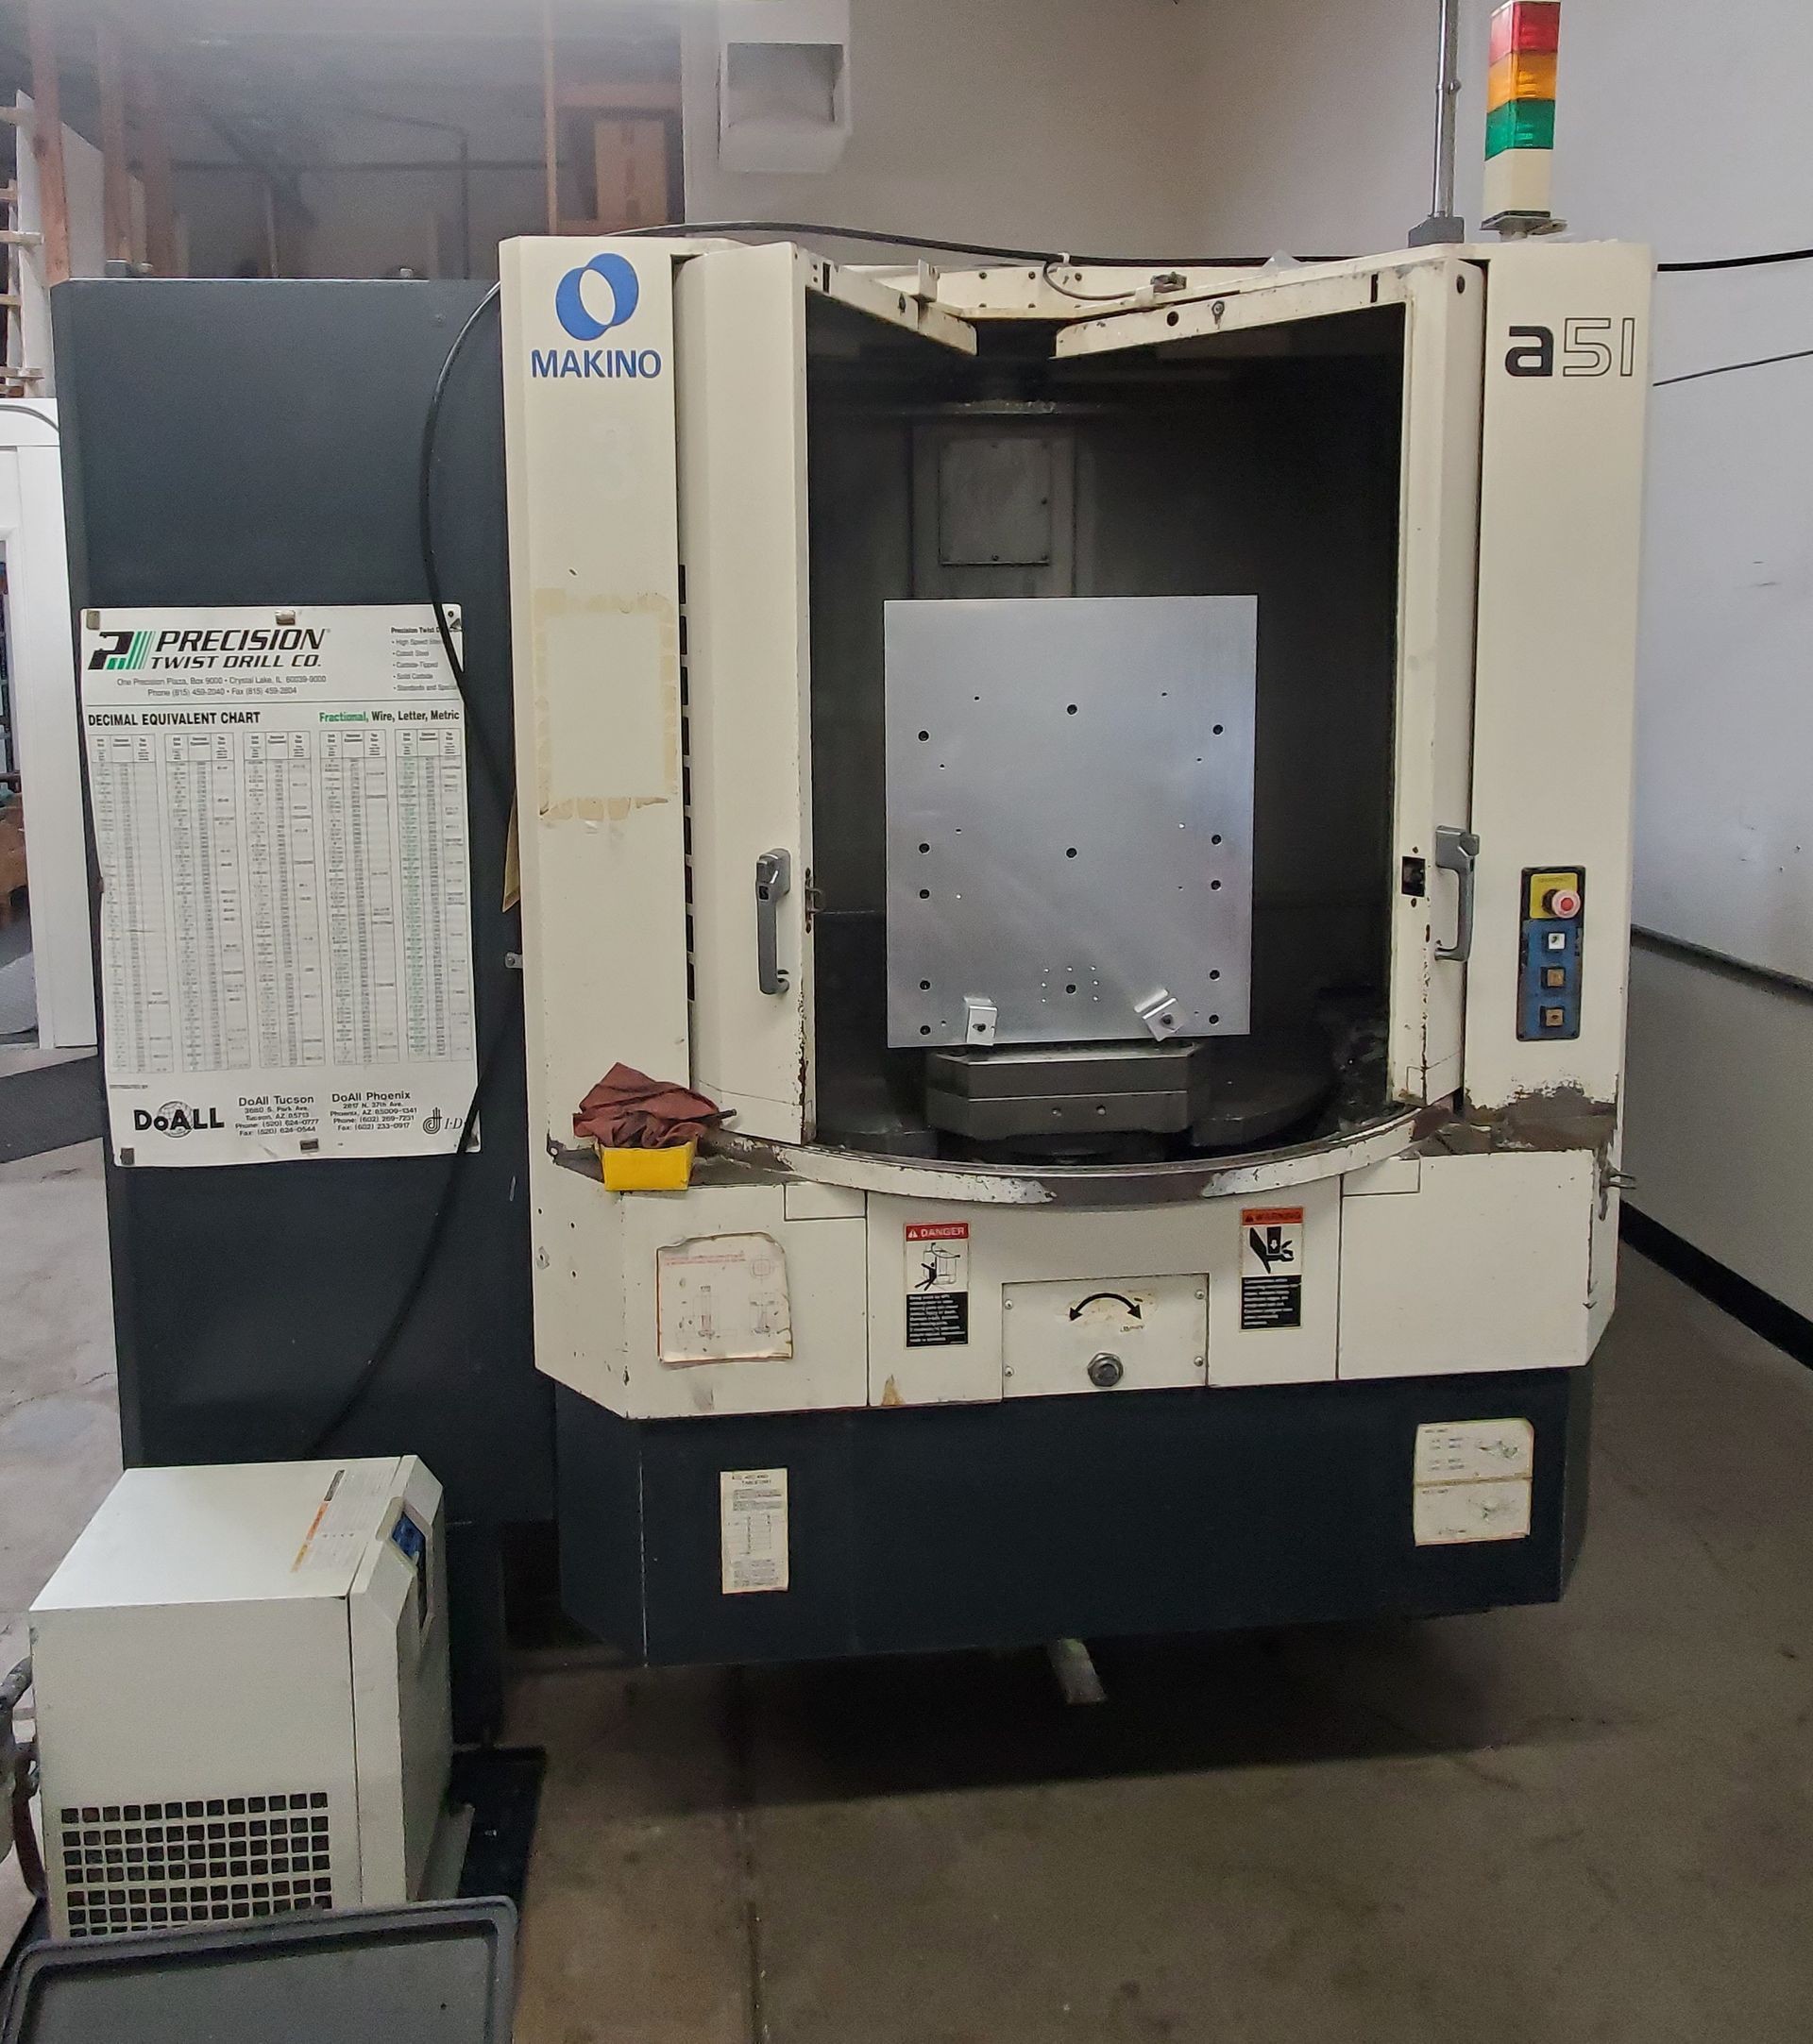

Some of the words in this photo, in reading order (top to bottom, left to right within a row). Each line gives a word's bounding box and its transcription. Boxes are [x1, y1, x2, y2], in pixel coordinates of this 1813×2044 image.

[531, 348, 662, 379] MAKINO
[155, 629, 325, 652] PRECISION
[151, 656, 219, 669] TWIST
[223, 654, 284, 668] DRILL
[291, 654, 322, 667] CO.
[246, 687, 263, 696] (815)
[88, 713, 138, 726] DECIMAL
[142, 712, 217, 727] EQUIVALENT
[220, 711, 261, 724] CHART
[319, 711, 369, 722] Fractional,
[371, 710, 396, 722] Wire,
[398, 709, 428, 721] Letter,
[430, 708, 460, 720] Metric
[238, 1096, 269, 1106] DoAll
[274, 1095, 314, 1105] Tucson
[331, 1092, 362, 1103] DoAll
[366, 1090, 411, 1101] Phoenix
[133, 1107, 225, 1131] DoALL
[920, 1226, 965, 1238] DANGER
